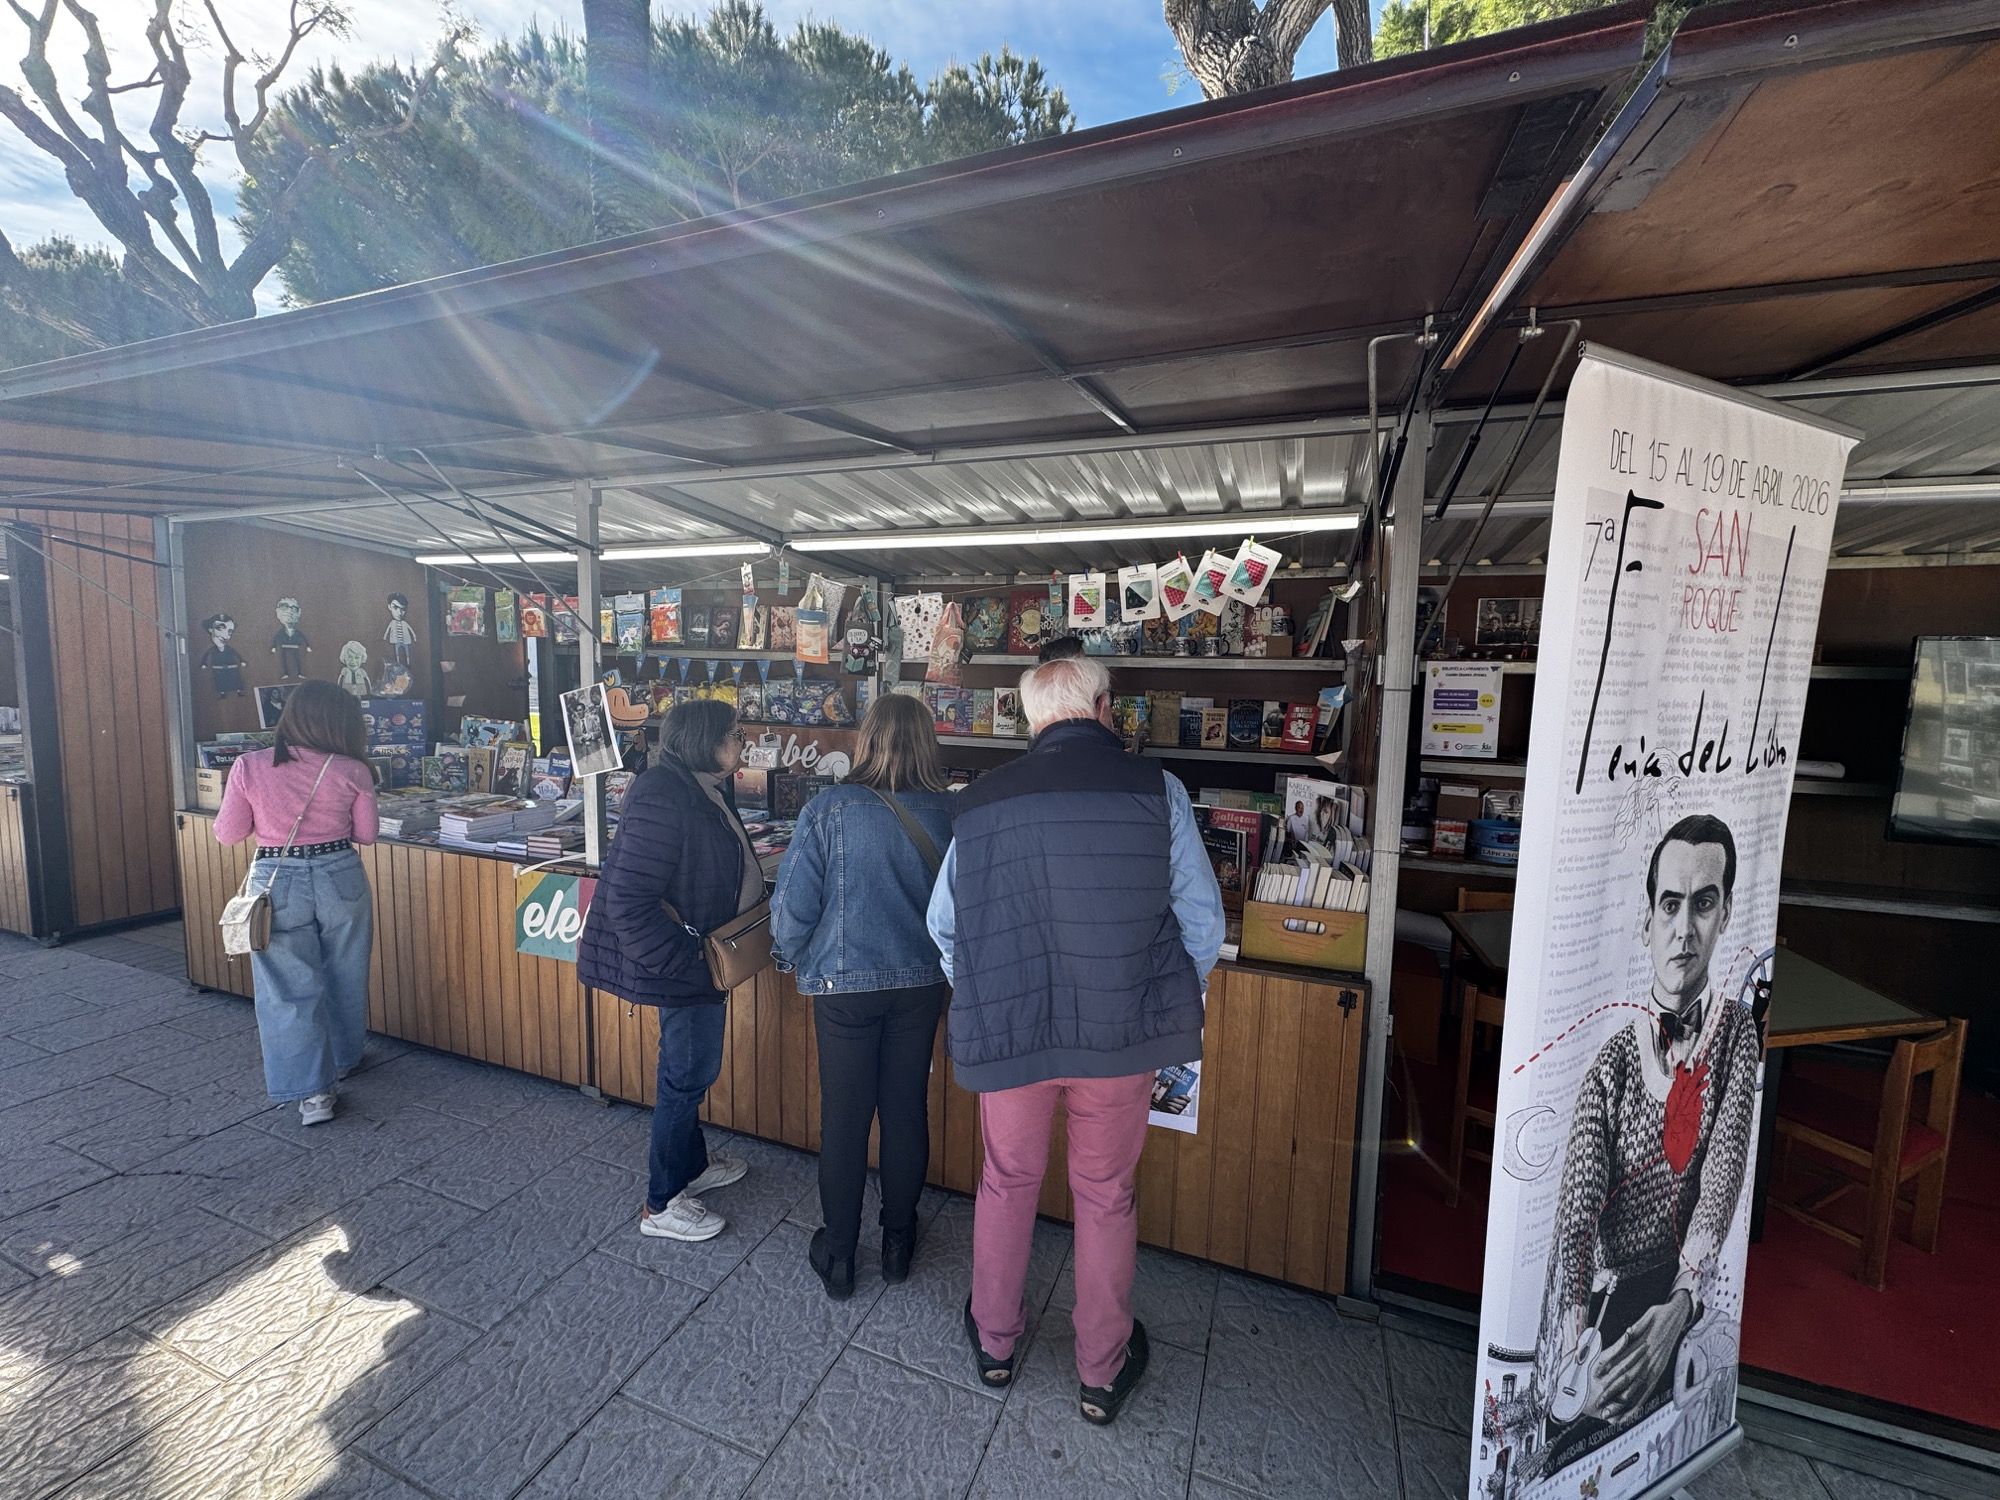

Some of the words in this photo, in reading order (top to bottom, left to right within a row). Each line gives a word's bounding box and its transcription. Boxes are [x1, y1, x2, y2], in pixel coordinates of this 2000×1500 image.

[1609, 428, 1637, 474] DEL
[1648, 437, 1670, 482] 15
[1675, 447, 1693, 486] AL
[1701, 452, 1725, 493] 19
[1728, 458, 1748, 498] DE
[1751, 464, 1783, 507] ABRIL
[1790, 474, 1830, 516] 2026
[1688, 508, 1752, 576] SAN
[1680, 585, 1742, 633] ROQUE
